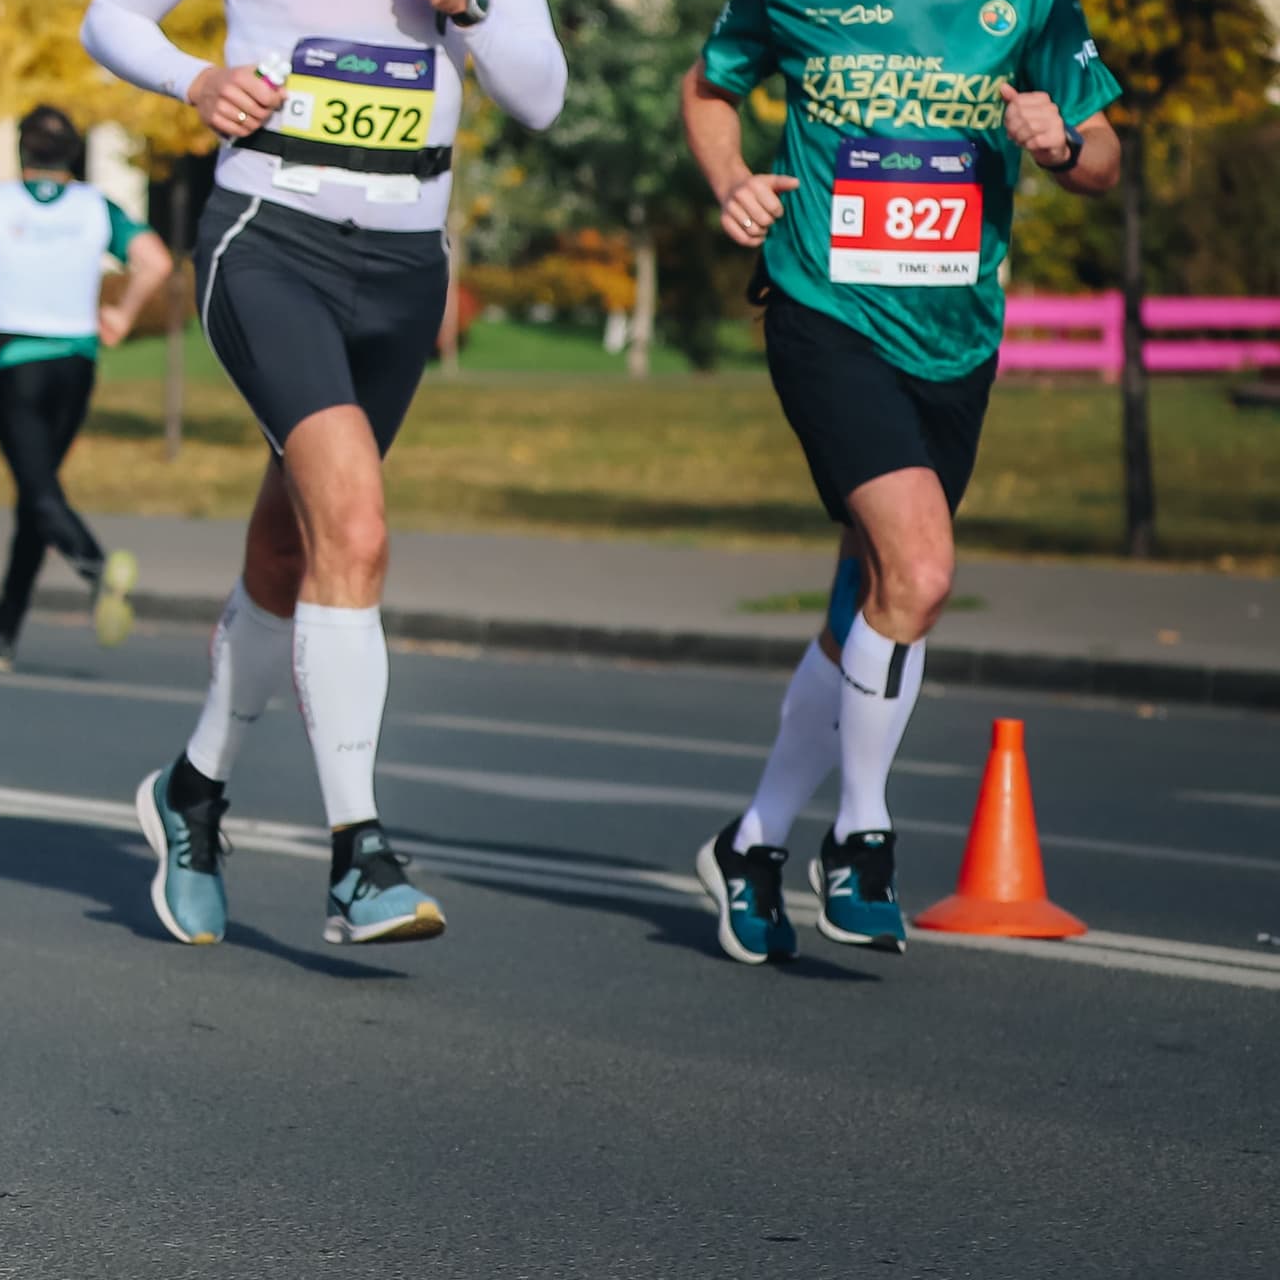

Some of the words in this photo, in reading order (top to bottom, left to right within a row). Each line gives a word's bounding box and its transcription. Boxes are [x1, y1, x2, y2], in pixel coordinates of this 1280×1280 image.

[829, 54, 886, 70] БАРС
[887, 55, 944, 71] БАНК
[803, 70, 1014, 102] КАЗАНСКИ
[322, 99, 422, 143] 3672
[842, 208, 855, 225] C
[885, 197, 966, 240] 827
